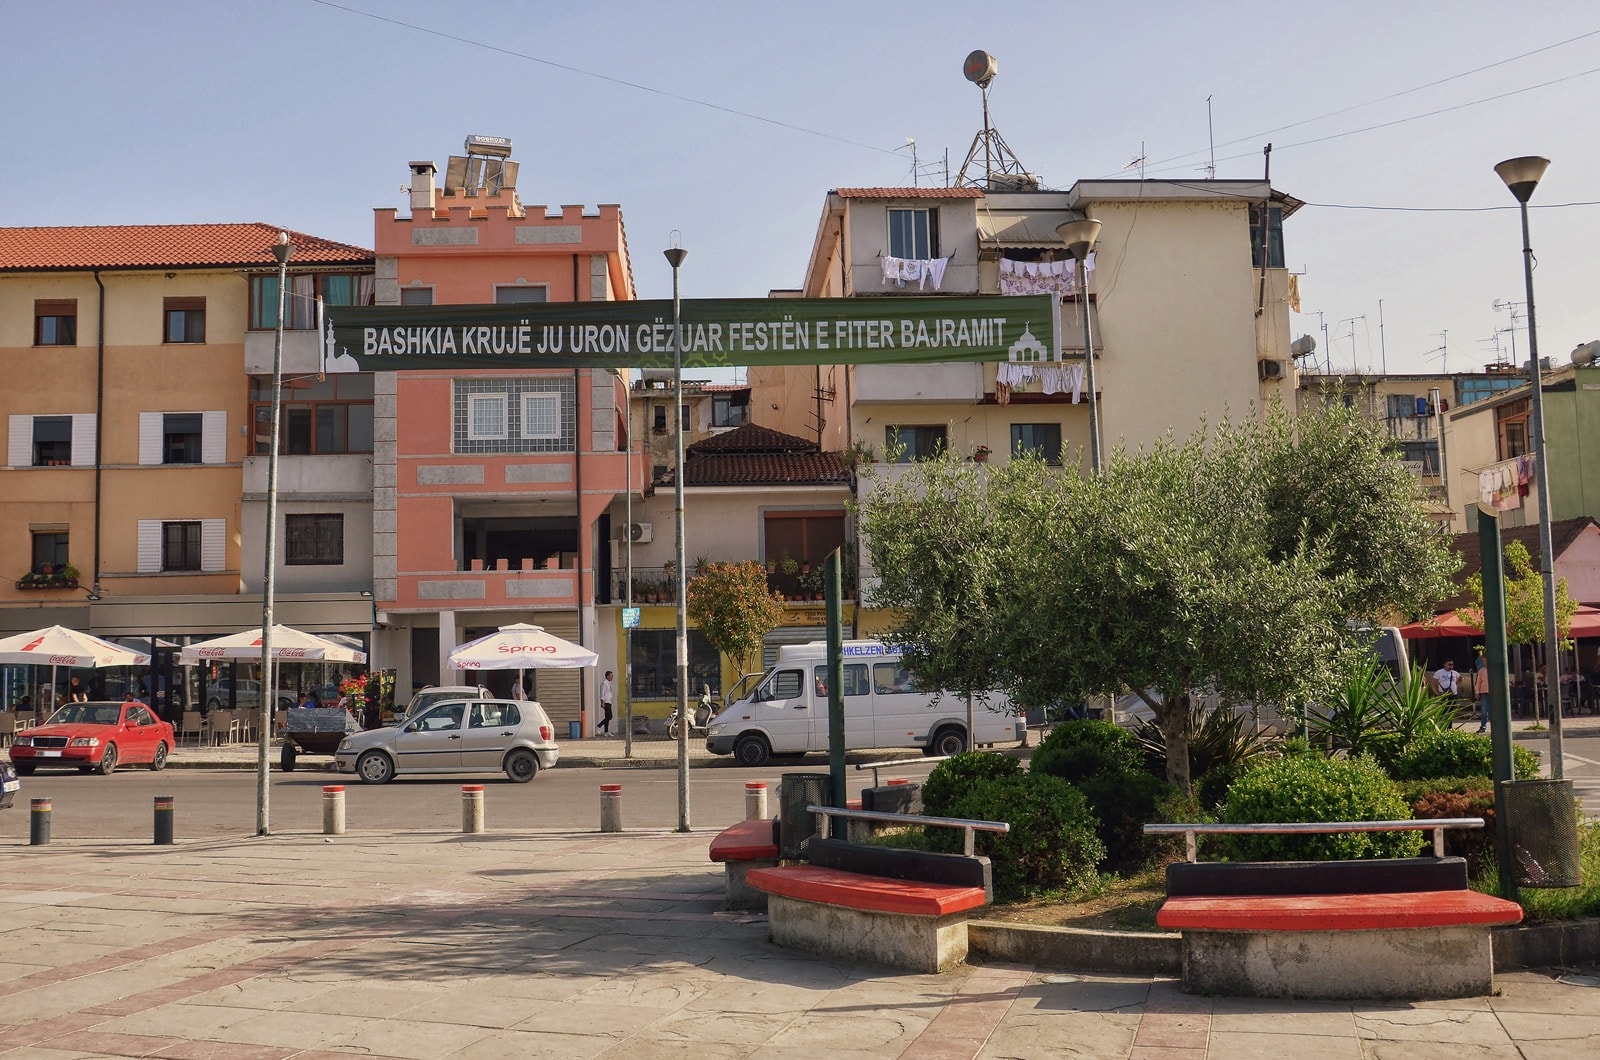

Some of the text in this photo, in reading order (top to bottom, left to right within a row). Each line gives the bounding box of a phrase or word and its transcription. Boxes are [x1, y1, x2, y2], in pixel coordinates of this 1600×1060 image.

[363, 315, 1007, 354] BASHKIA KRUJË JU URON GËZUAR FESTËN E FITER BAJRAMIT
[843, 645, 884, 656] HKELZENI
